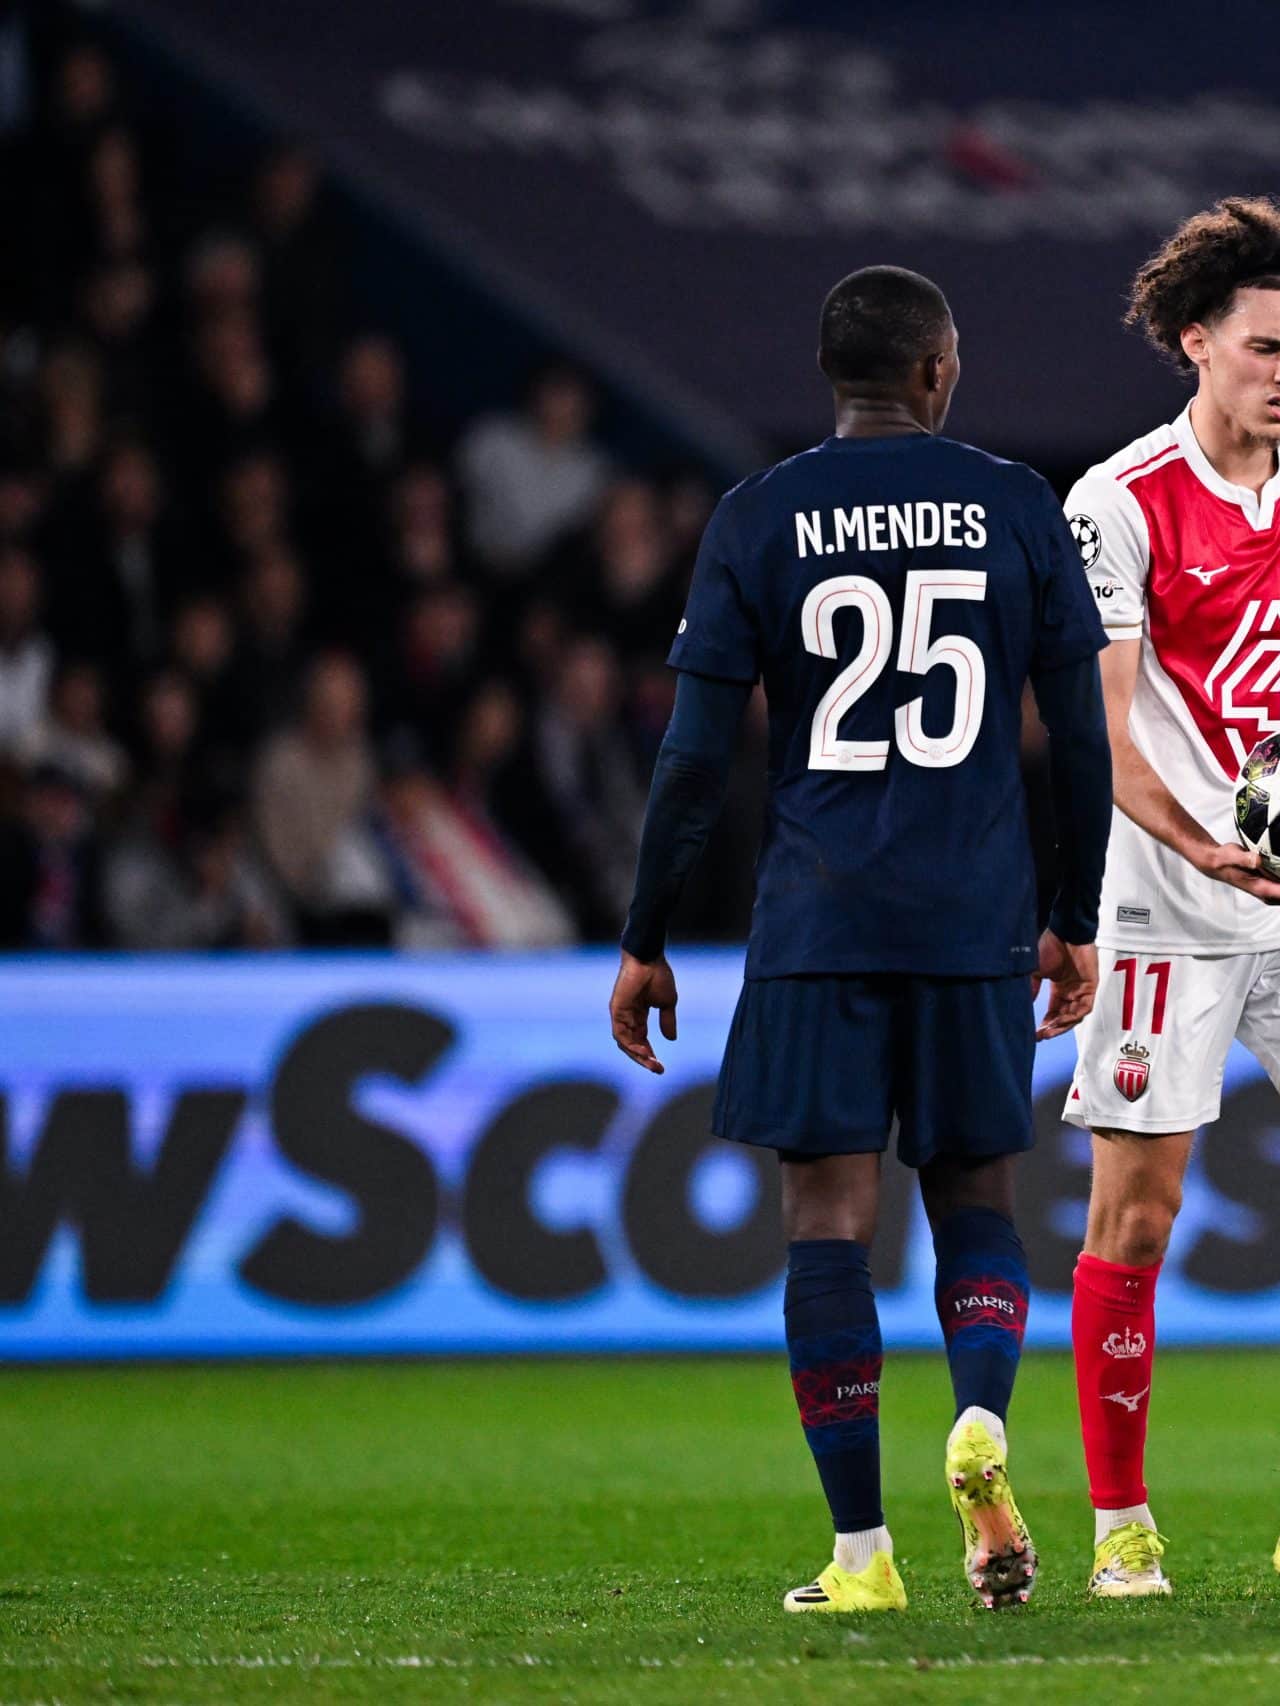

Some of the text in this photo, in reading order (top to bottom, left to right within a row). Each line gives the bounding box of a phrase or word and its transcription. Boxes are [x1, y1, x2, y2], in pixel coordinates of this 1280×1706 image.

[795, 501, 987, 558] N.MENDES
[801, 569, 987, 771] 25
[1113, 957, 1171, 1035] 11
[955, 1296, 1014, 1315] PARIS
